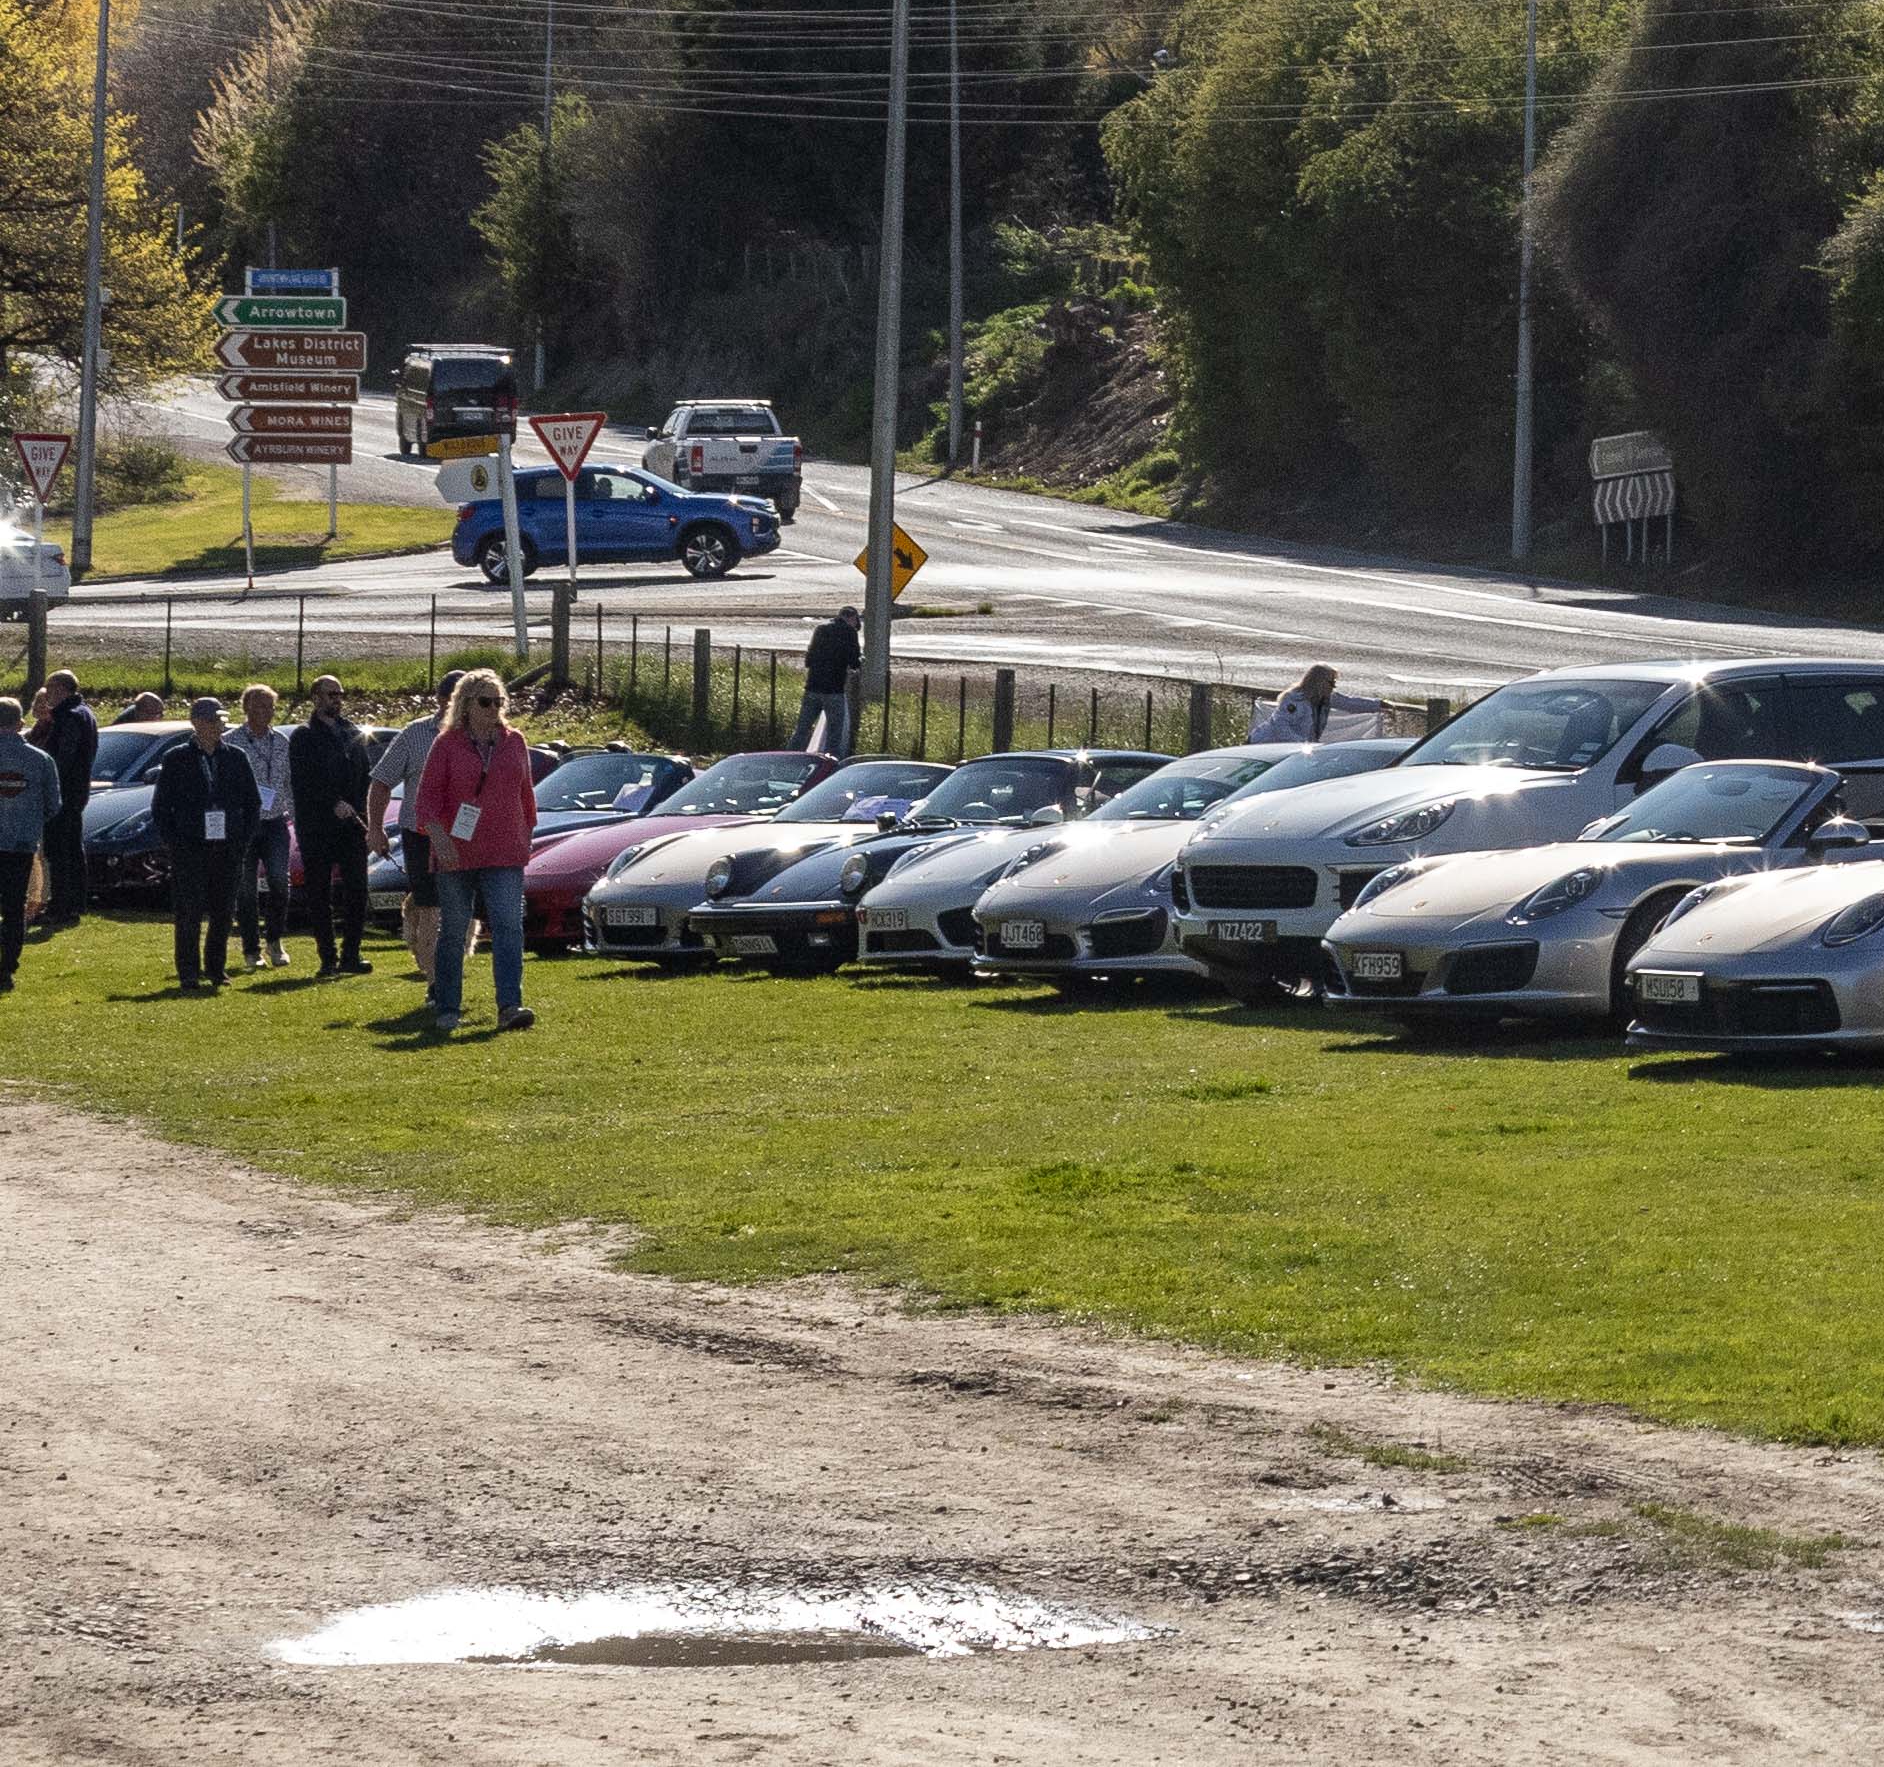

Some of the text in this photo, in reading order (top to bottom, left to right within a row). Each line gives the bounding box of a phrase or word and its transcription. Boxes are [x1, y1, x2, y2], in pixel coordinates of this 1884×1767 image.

[249, 305, 336, 320] Arrowtown
[253, 337, 359, 351] Lakes District
[276, 352, 337, 365] Museum
[249, 381, 351, 395] Amisfield Winery
[267, 416, 350, 426] MORA WINES
[553, 425, 584, 441] GIVE
[31, 446, 56, 461] GIVE
[306, 445, 345, 457] WINERY
[559, 444, 580, 456] WAY
[1218, 922, 1264, 941] NZZ422
